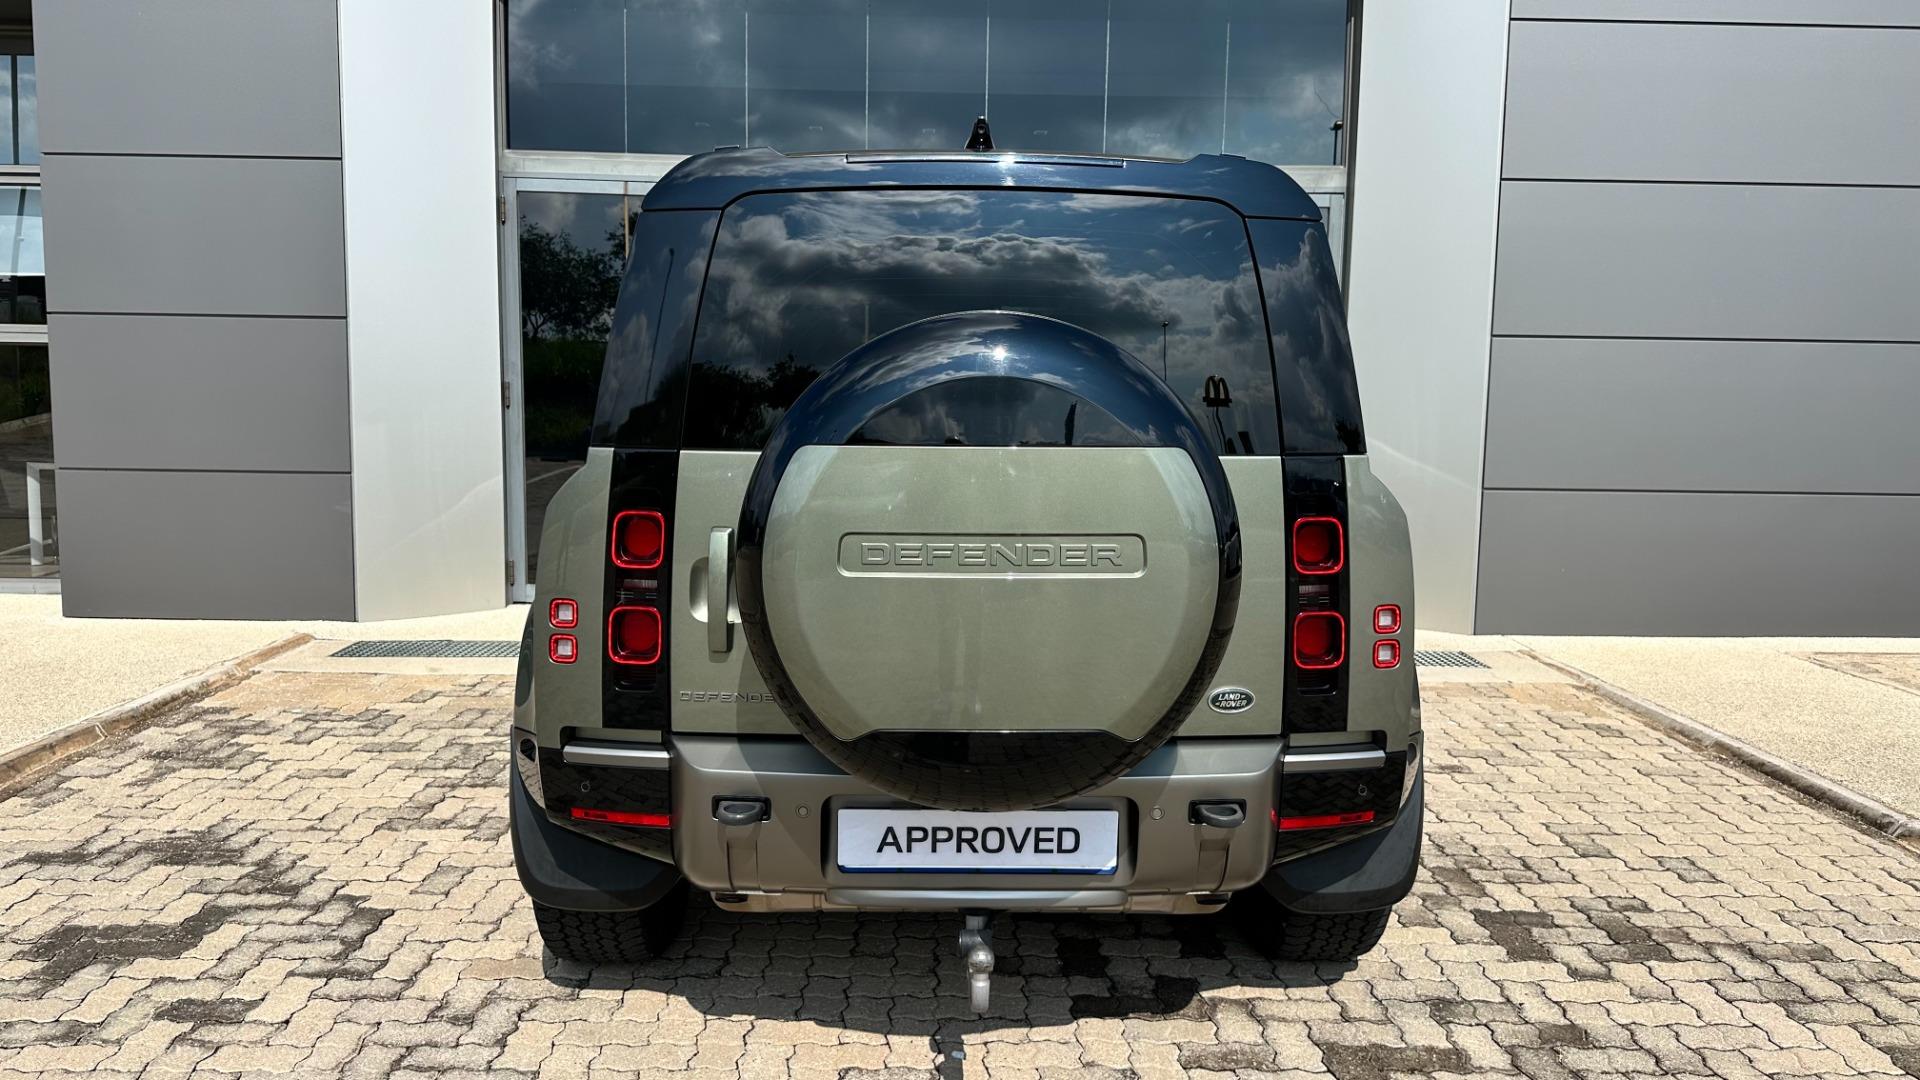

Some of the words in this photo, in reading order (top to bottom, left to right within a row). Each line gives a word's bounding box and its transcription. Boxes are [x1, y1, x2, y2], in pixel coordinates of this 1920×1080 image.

[861, 542, 1123, 567] DEFENDER
[680, 691, 777, 703] DEFENDE
[1218, 693, 1241, 701] LAND
[1219, 700, 1248, 708] ROVER
[876, 826, 1081, 854] APPROVED
